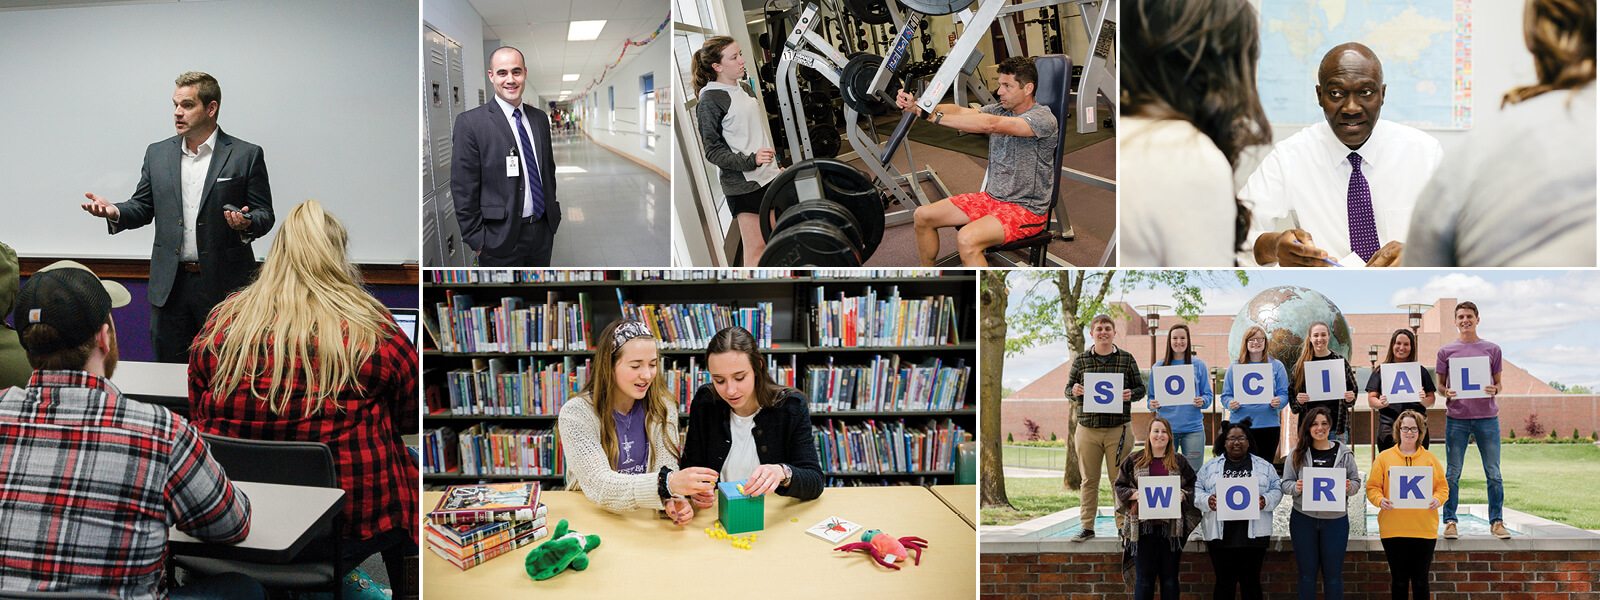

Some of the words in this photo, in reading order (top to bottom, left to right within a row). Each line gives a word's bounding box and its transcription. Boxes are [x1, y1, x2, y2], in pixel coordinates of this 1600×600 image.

[1164, 375, 1185, 396] O
[1242, 372, 1264, 396] C
[1321, 369, 1331, 393] I
[1390, 371, 1415, 395] A
[1461, 367, 1481, 391] L
[1093, 381, 1115, 405] S
[1144, 486, 1173, 508] W
[1225, 485, 1251, 511] O
[1312, 477, 1337, 502] R
[1399, 475, 1425, 500] K
